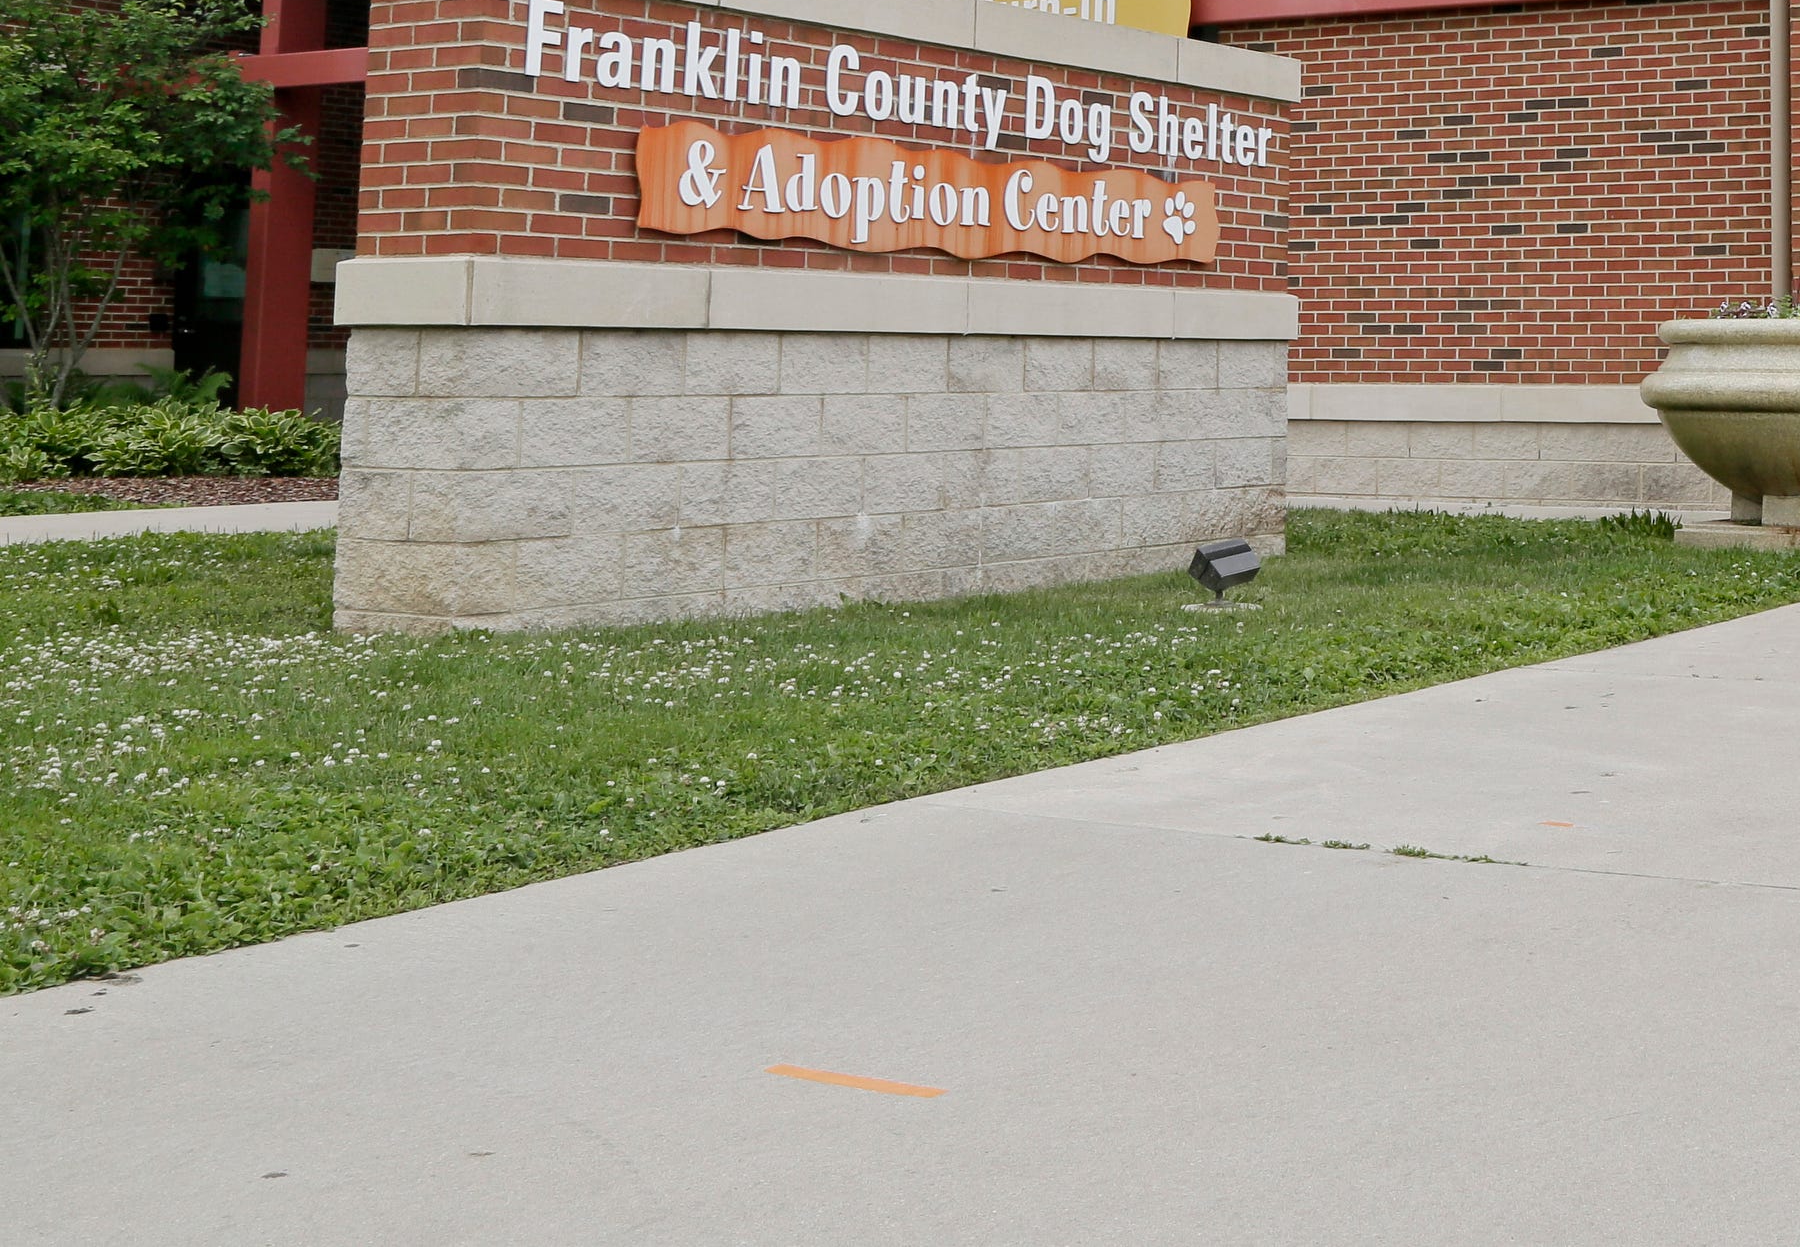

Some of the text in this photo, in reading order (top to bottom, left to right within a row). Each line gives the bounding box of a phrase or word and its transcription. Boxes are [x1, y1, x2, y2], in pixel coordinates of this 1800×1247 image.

[825, 43, 1008, 151] County
[1026, 74, 1113, 164] Dog
[1129, 87, 1273, 168] Shelter
[677, 125, 1153, 245] & Adoption Center
